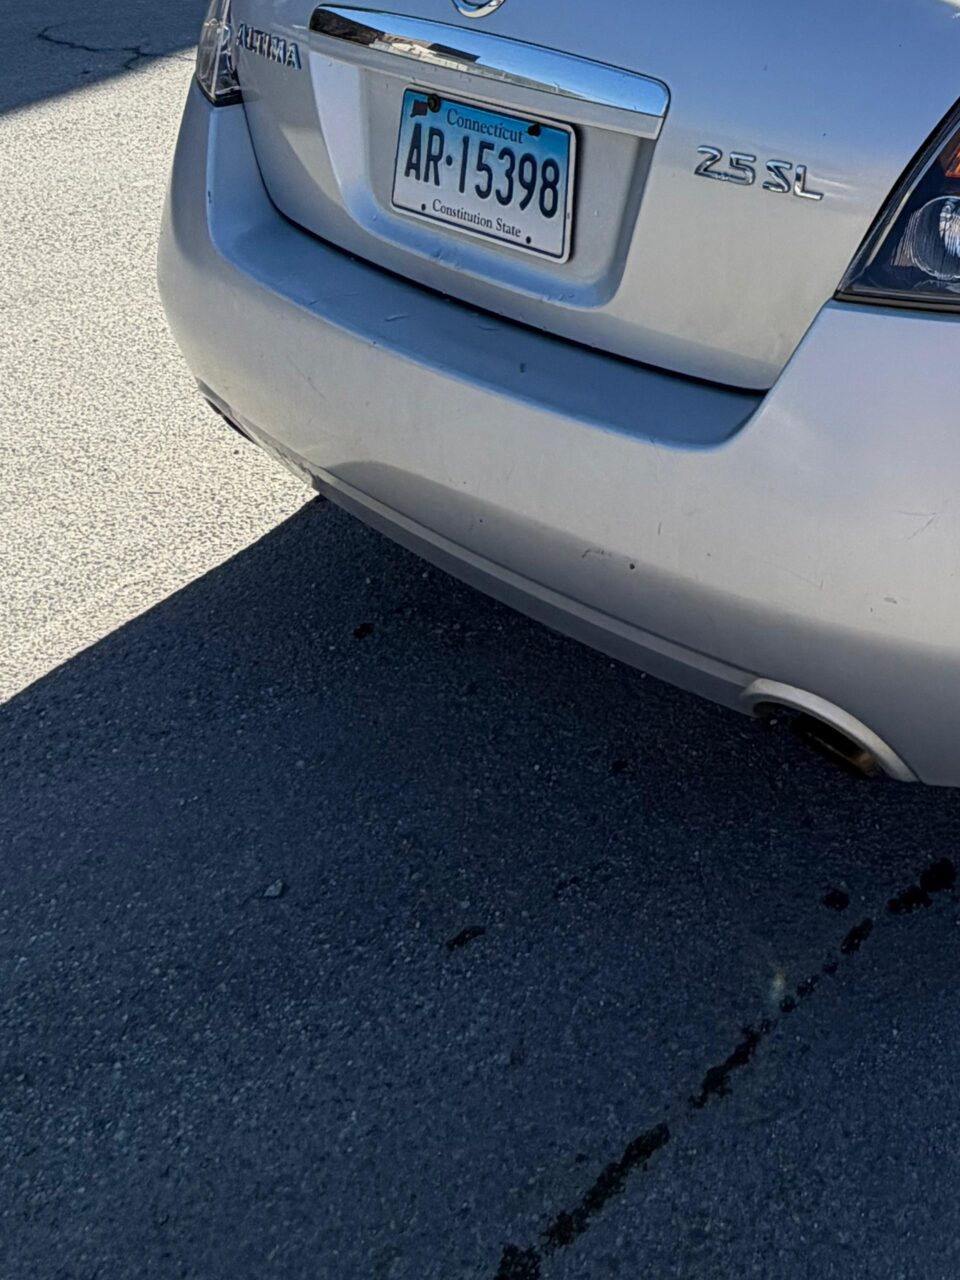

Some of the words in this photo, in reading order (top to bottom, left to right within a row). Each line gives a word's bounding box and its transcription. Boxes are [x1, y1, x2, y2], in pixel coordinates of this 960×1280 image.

[236, 23, 302, 70] ALTIMA
[446, 108, 524, 144] Connecticut
[762, 159, 824, 200] SL
[432, 198, 493, 230] Constitution
[497, 218, 522, 238] State
